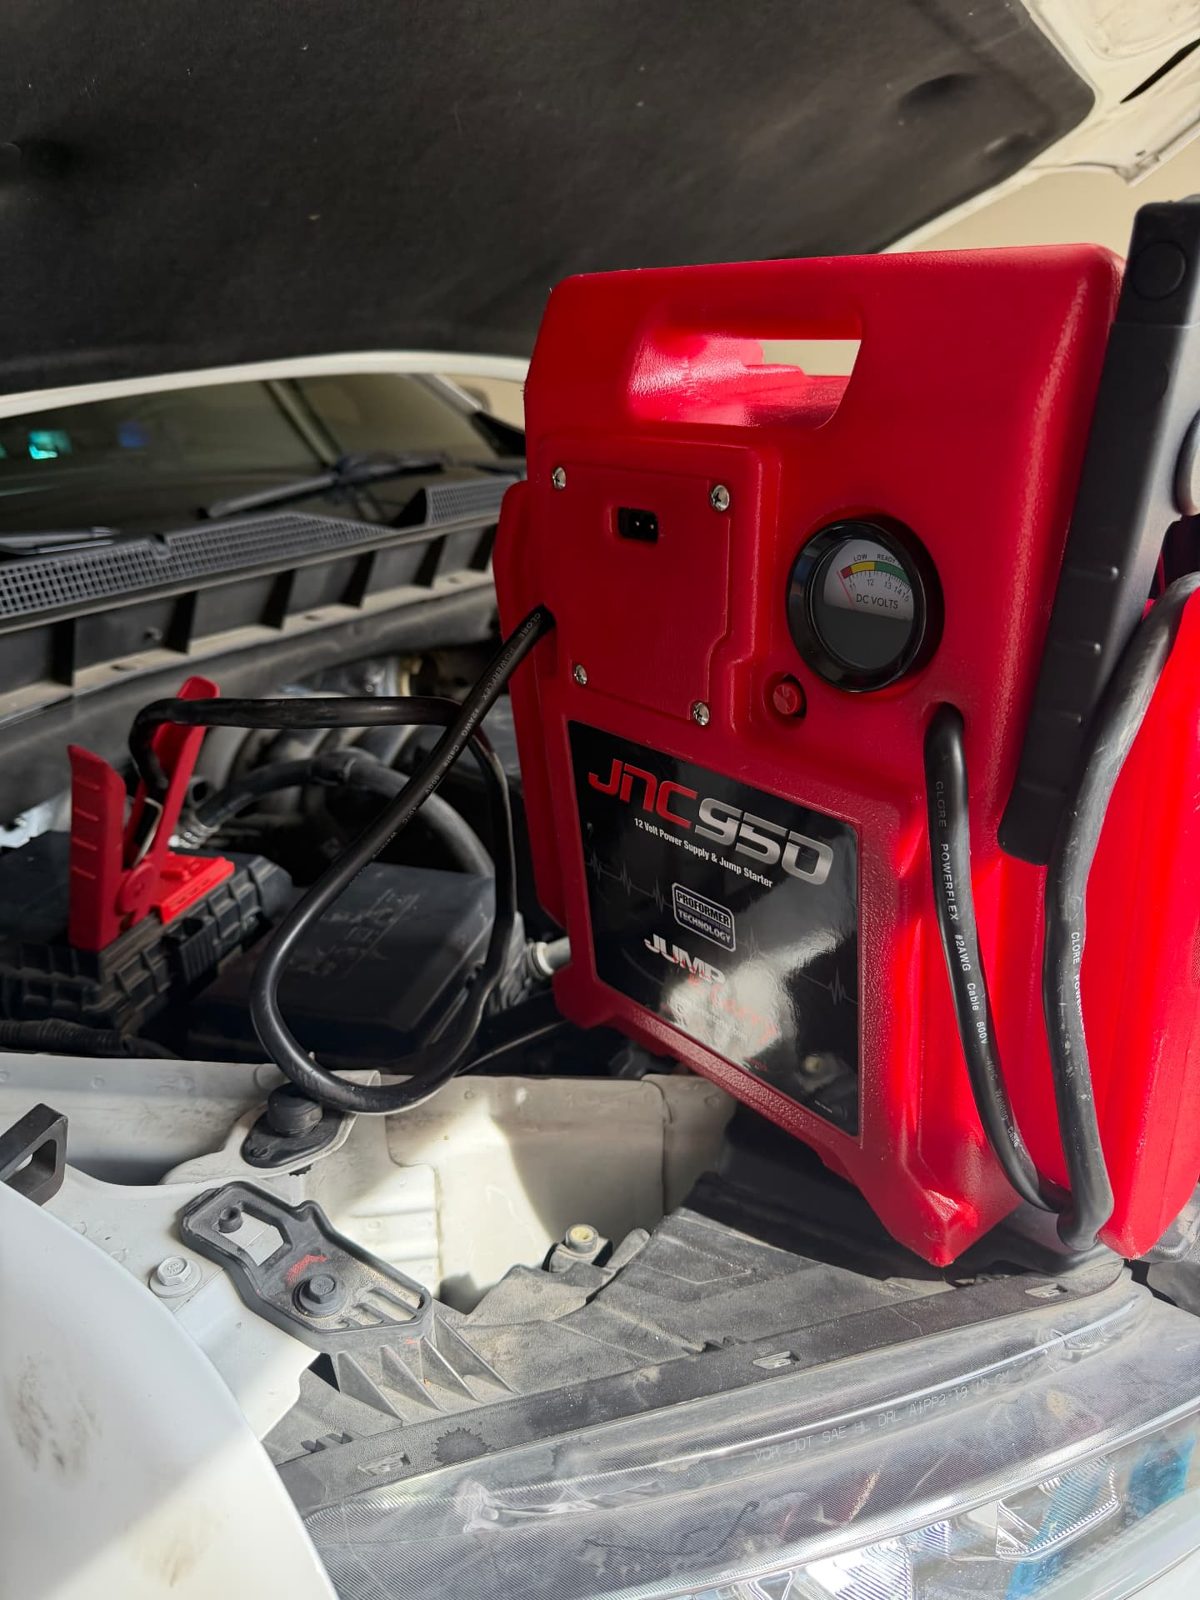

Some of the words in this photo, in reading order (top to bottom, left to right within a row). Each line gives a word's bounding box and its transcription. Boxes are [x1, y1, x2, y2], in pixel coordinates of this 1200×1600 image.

[853, 554, 867, 562] LOW
[877, 554, 896, 563] READY
[849, 583, 856, 592] 11
[867, 578, 874, 587] 12
[884, 581, 892, 590] 13
[894, 586, 902, 596] 14
[902, 592, 909, 602] 15
[856, 594, 868, 604] DC
[871, 597, 898, 609] VOLTS
[633, 817, 644, 829] 12
[644, 820, 659, 835] Volt
[659, 827, 683, 848] Power
[683, 837, 710, 860] Supply
[711, 853, 718, 864] &
[719, 856, 742, 876] Jump
[743, 866, 774, 888] Starter
[676, 891, 730, 926] PROFORMER
[677, 909, 731, 943] TECHNOLOGY
[940, 843, 959, 921] POWERFLEX
[954, 934, 972, 972] #2AWG
[966, 982, 980, 1012] Cable
[976, 1020, 989, 1045] 600V
[1070, 931, 1080, 965] CLORE
[822, 1425, 847, 1443] SAE
[877, 1411, 903, 1428] DRL
